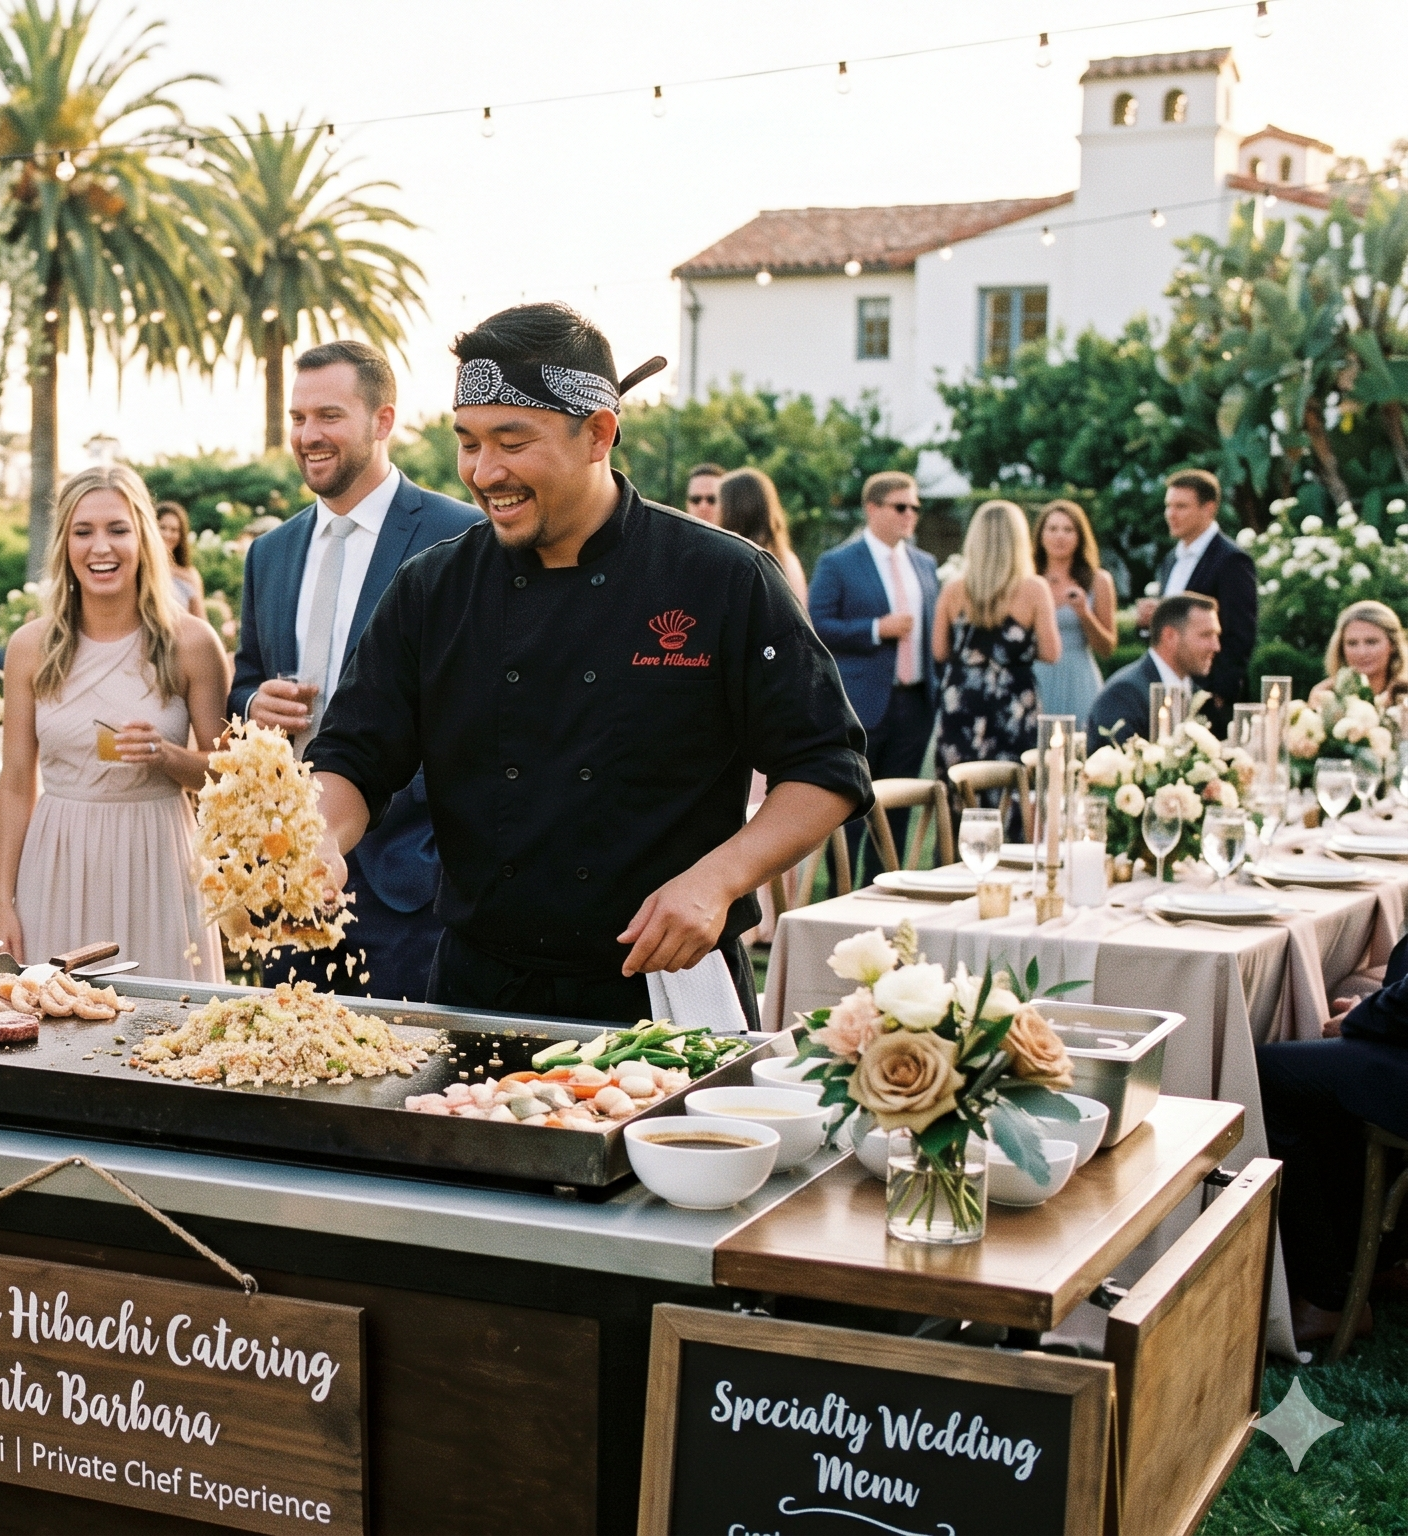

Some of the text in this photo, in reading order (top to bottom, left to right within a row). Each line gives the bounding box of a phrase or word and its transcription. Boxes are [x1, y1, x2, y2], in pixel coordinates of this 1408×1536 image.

[631, 651, 661, 666] Love
[8, 1285, 160, 1356] Hibachi
[166, 1313, 341, 1403] Catering
[56, 1370, 221, 1447] Barbara
[710, 1380, 1042, 1481] Specialty Wedding
[32, 1441, 117, 1483] Private
[124, 1460, 183, 1495] Chef
[189, 1471, 332, 1524] Experience
[812, 1452, 921, 1508] Menu
